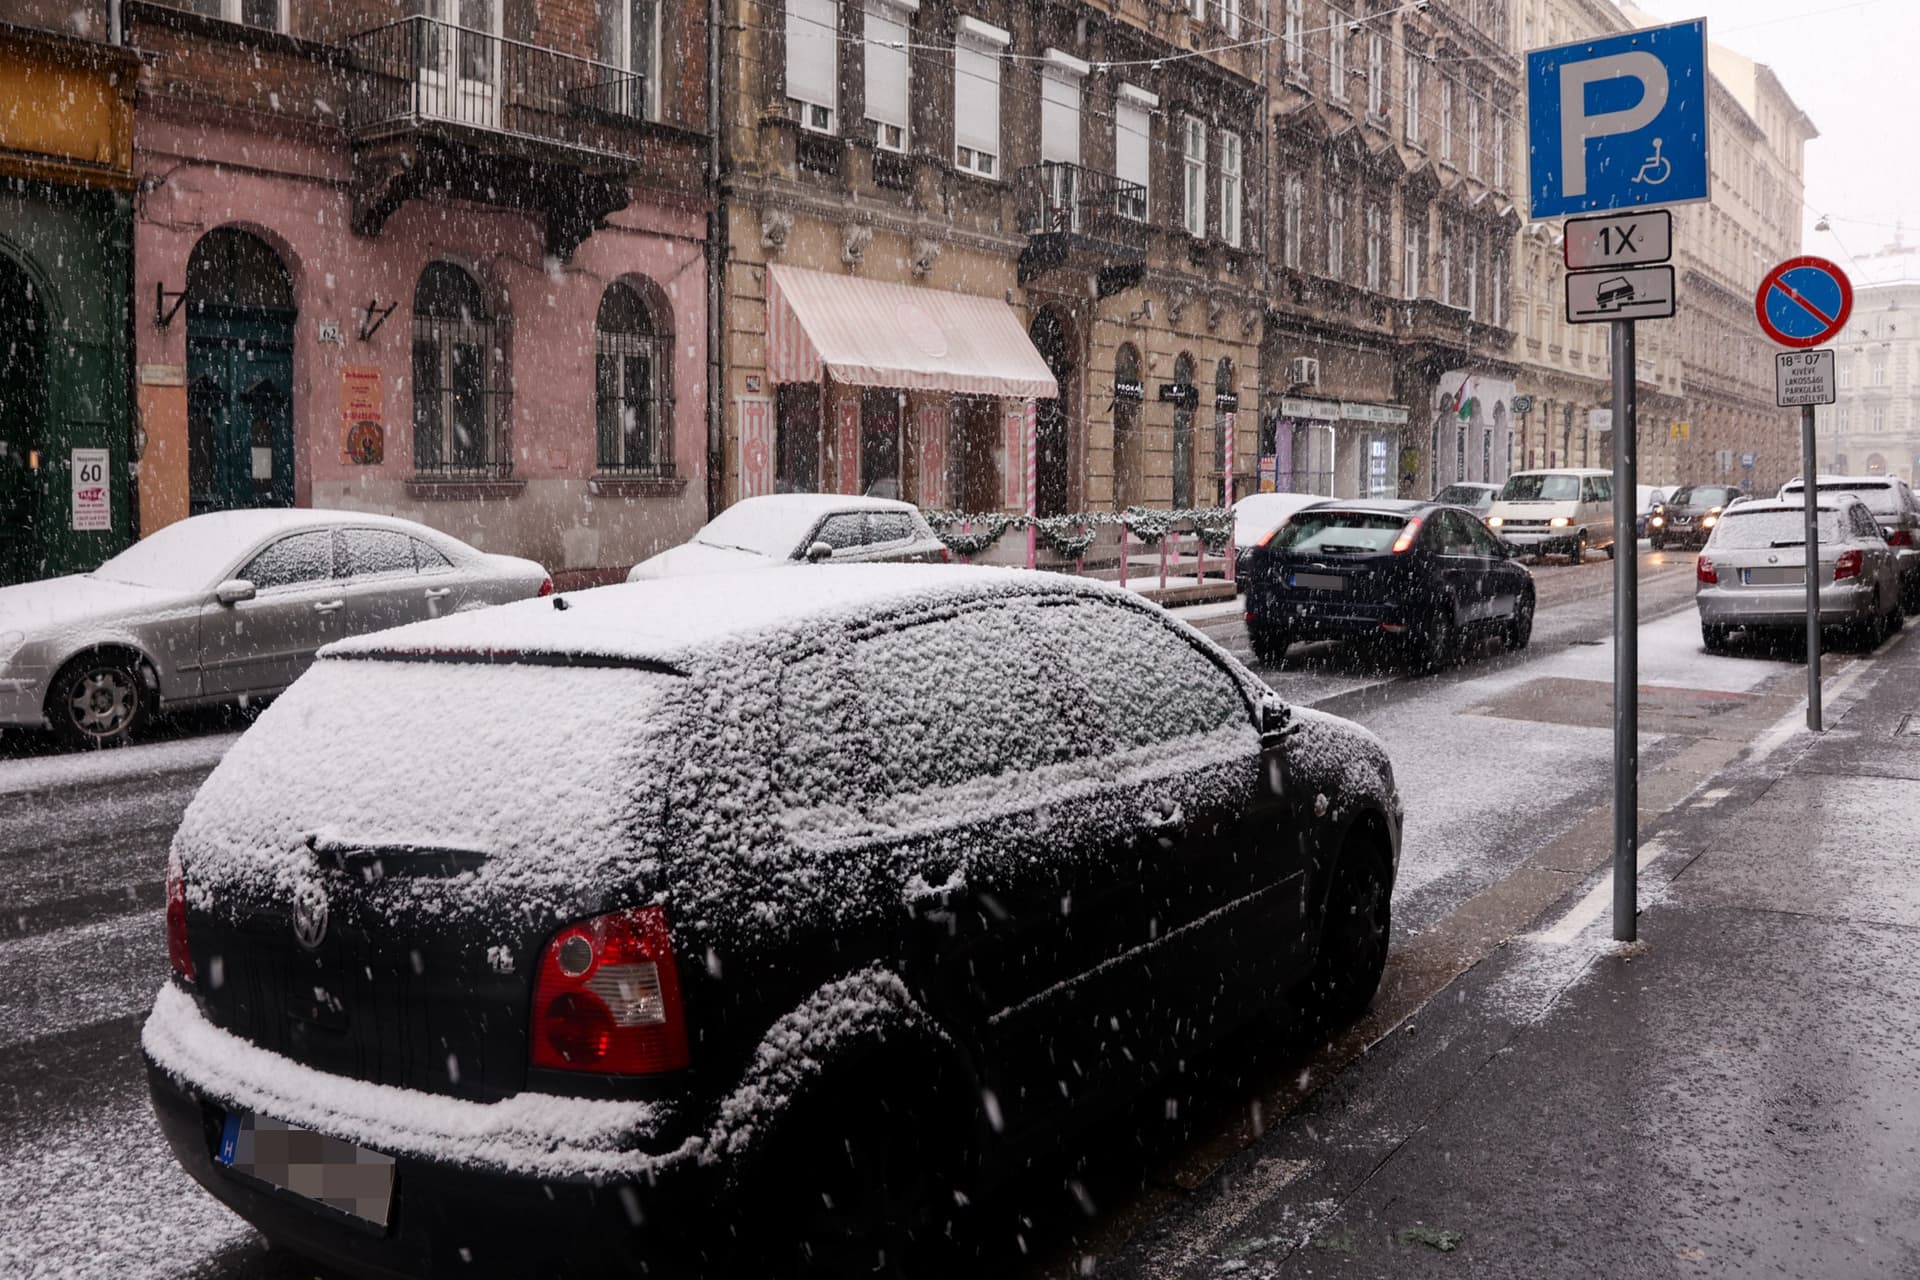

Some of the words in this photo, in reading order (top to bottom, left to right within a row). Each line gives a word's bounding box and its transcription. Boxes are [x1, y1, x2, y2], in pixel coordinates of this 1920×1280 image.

[1560, 51, 1669, 197] P
[1599, 224, 1637, 256] 1X
[323, 328, 337, 339] 62
[80, 464, 102, 482] 60
[224, 1139, 234, 1158] H
